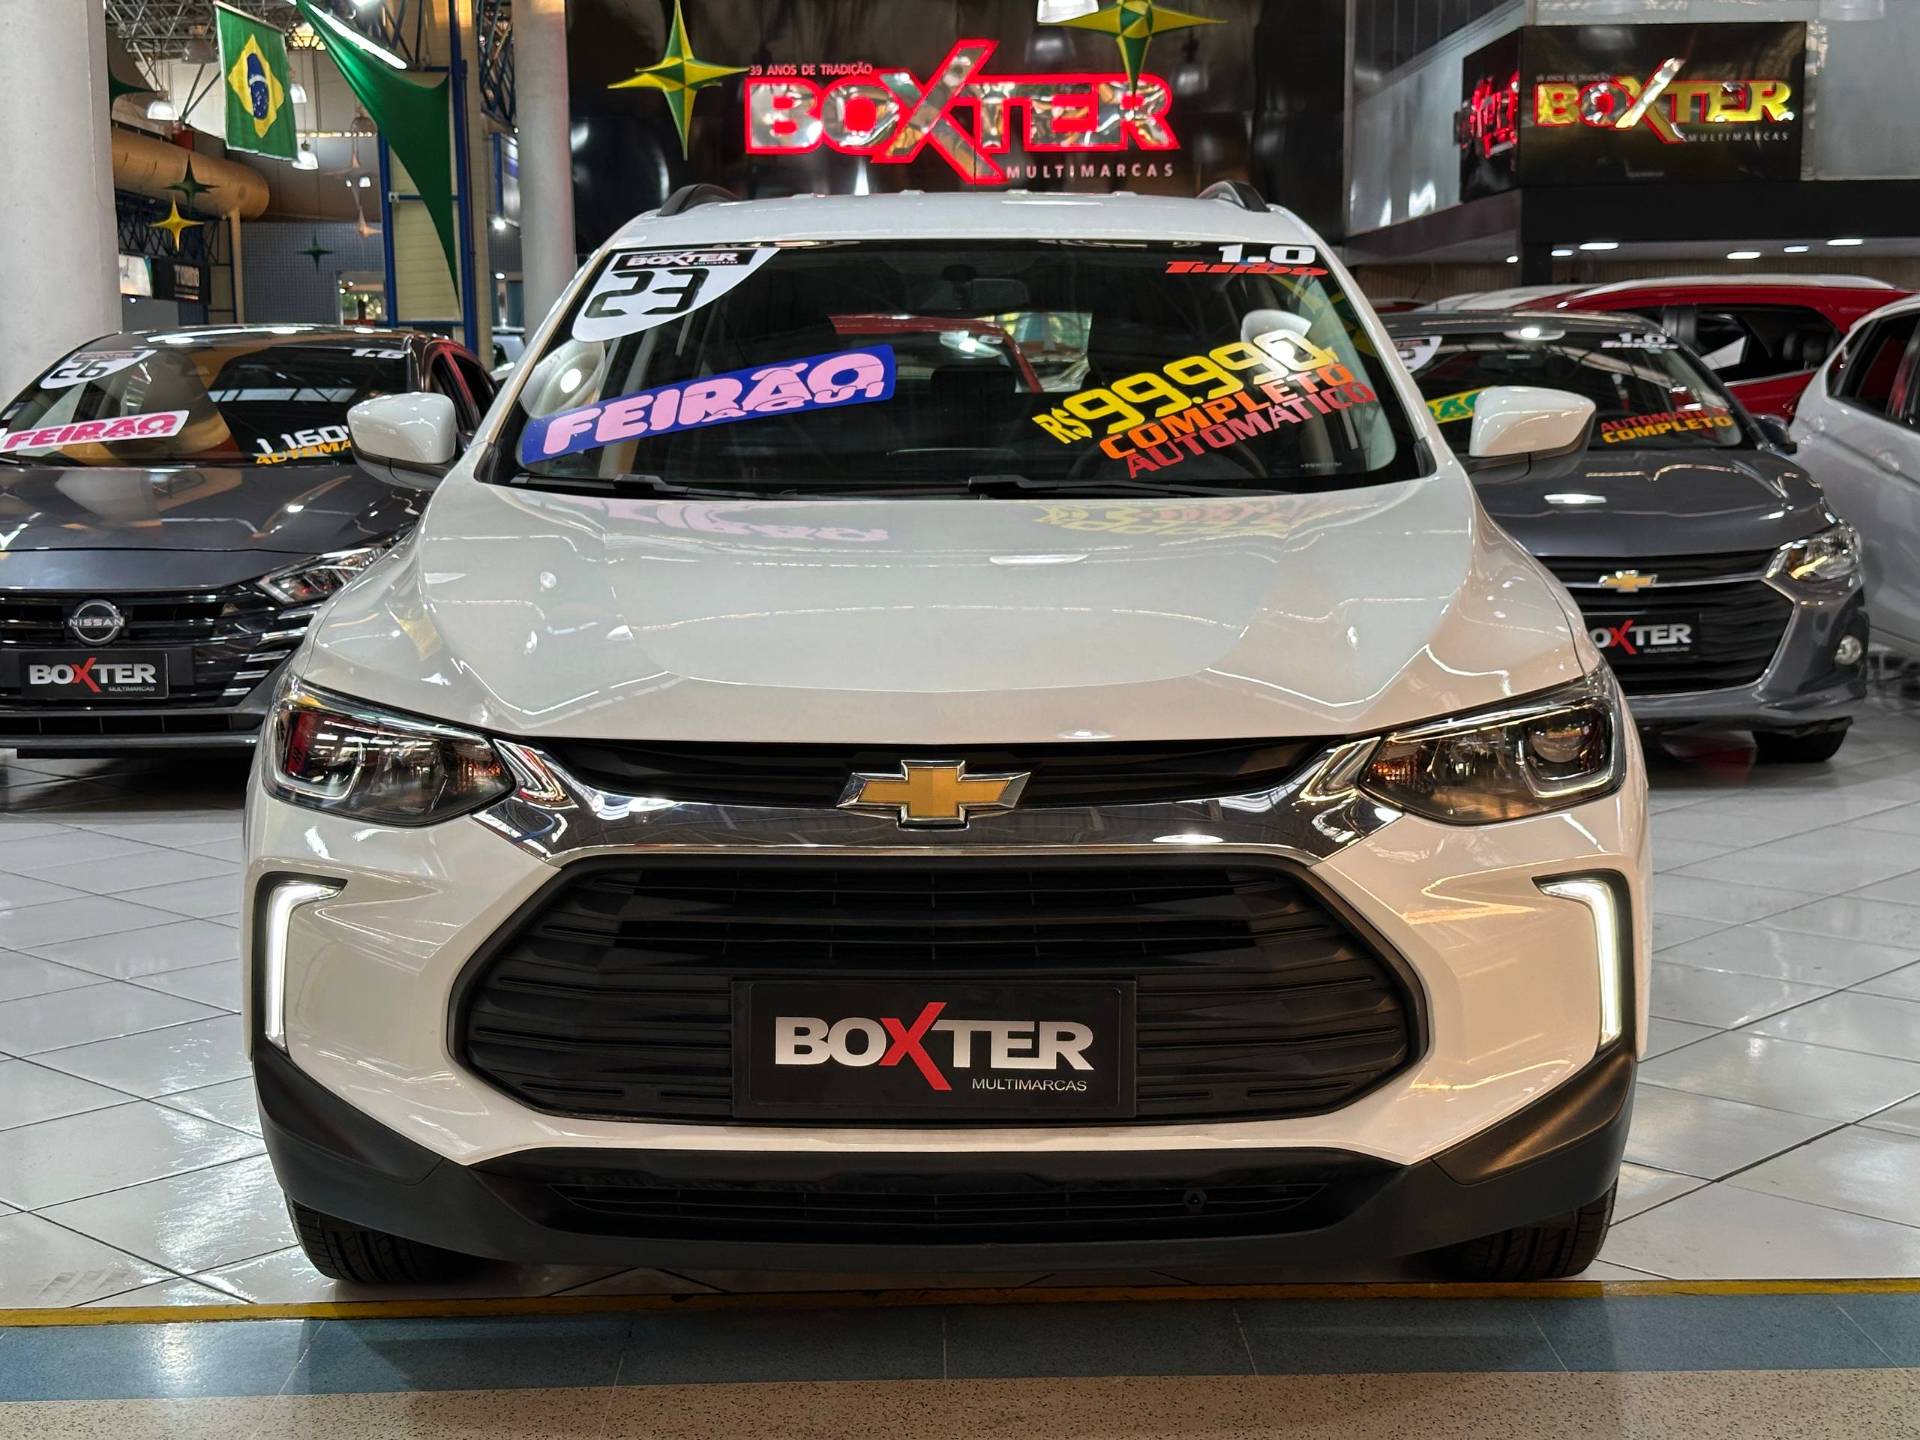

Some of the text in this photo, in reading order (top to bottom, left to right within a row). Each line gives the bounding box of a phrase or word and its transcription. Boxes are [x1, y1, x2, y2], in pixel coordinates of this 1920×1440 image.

[749, 61, 873, 76] 39 ANOS DE TRADIÇÃO
[745, 39, 1180, 185] BOXTER
[1534, 57, 1795, 144] BOXTER
[1006, 164, 1174, 178] MULTIMARCAS
[626, 252, 738, 266] BOXTER
[1218, 244, 1316, 264] 1.0
[584, 268, 710, 318] 23
[50, 358, 116, 378] 26
[543, 353, 884, 455] FEIRÃO
[1100, 364, 1355, 460] COMPLETO
[4, 414, 177, 449] FEIRÃO
[1602, 416, 1734, 443] COMPLETO
[69, 617, 125, 627] NISSAN
[1590, 619, 1692, 655] OXTER
[30, 656, 157, 693] BOXTER
[775, 1002, 1094, 1091] BOXTER
[972, 1078, 1087, 1091] MULTIMARCAS
